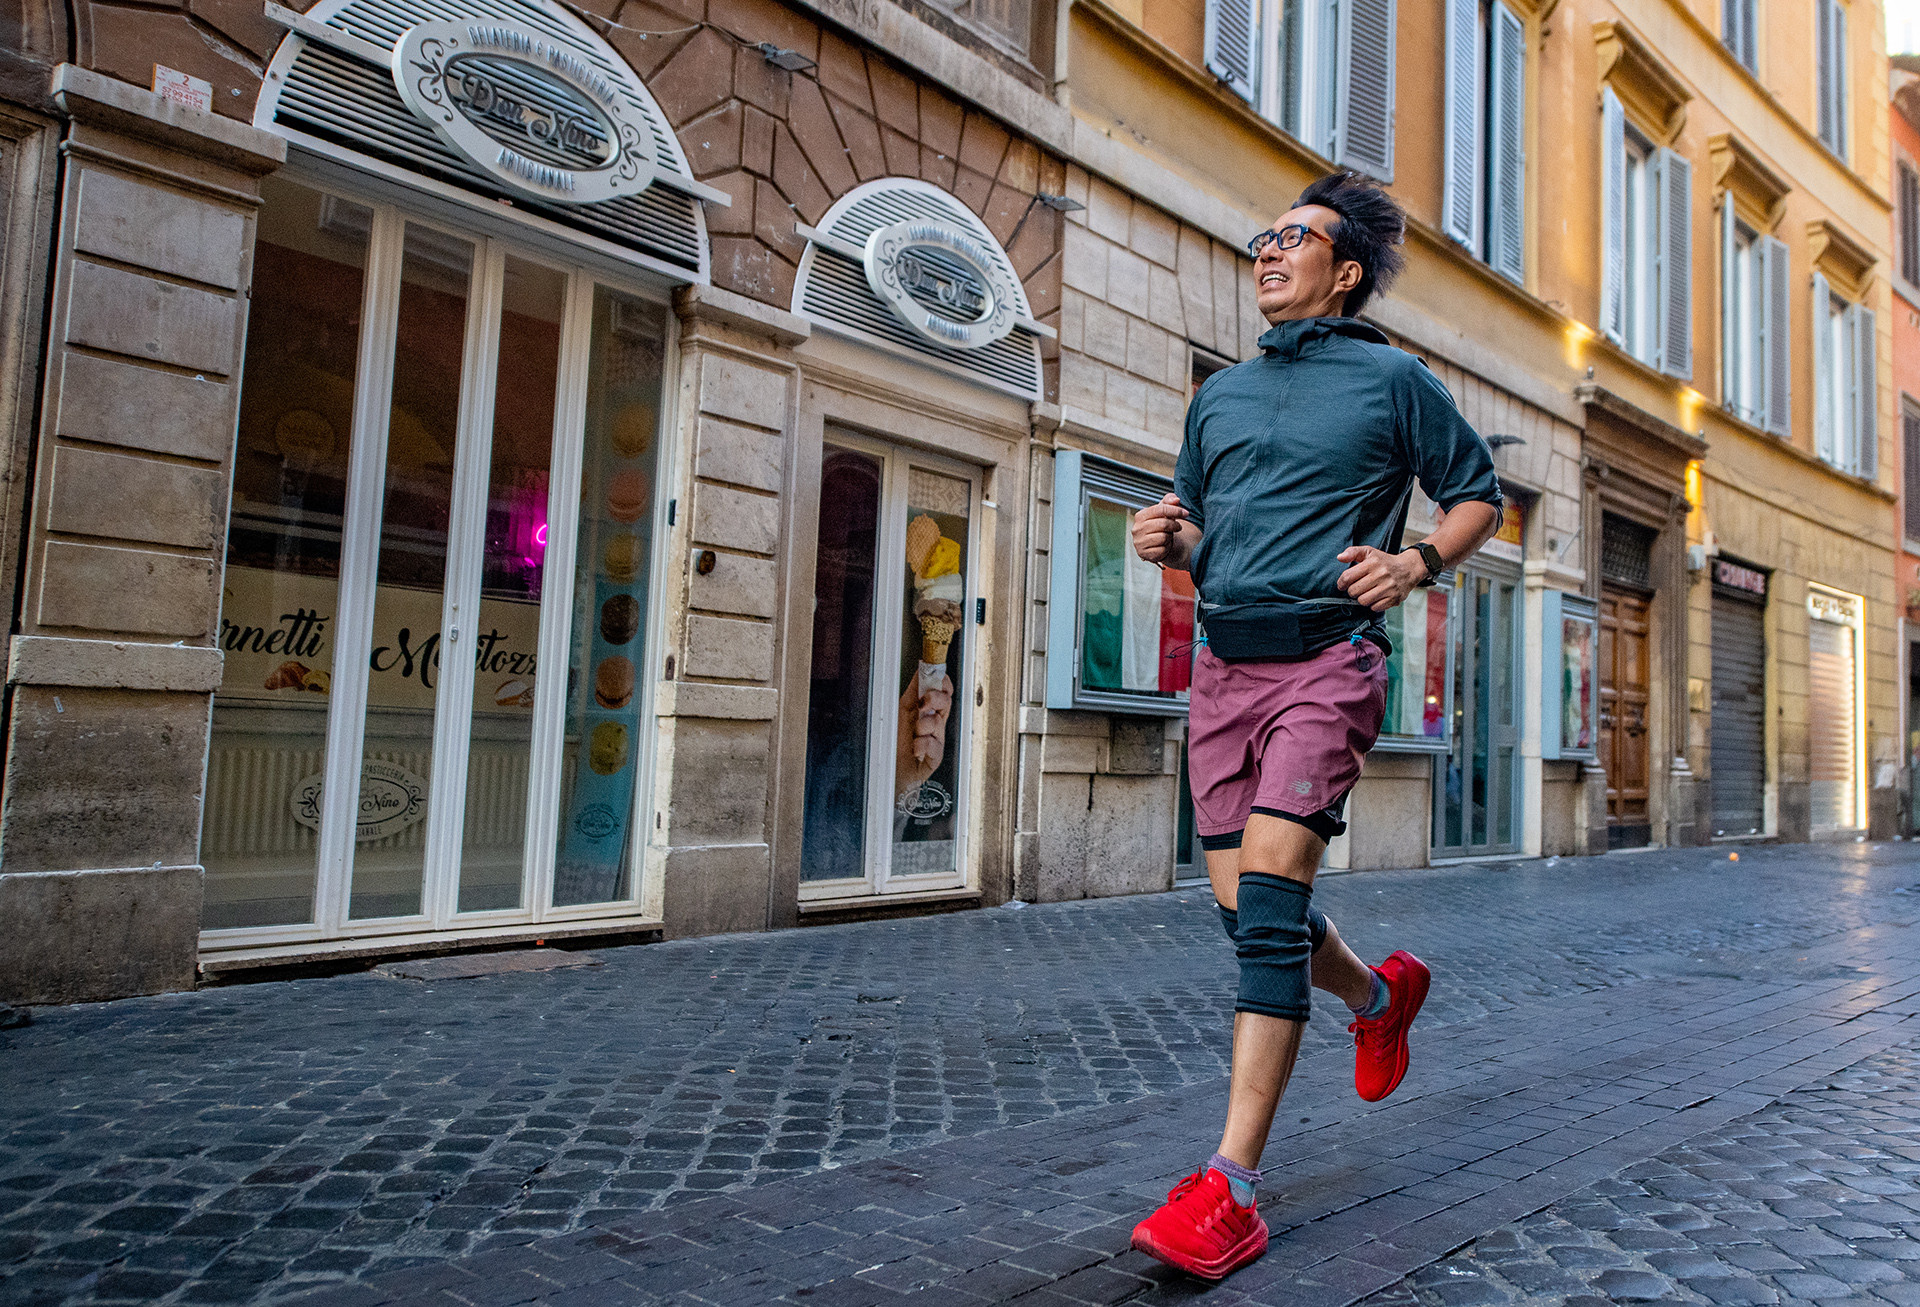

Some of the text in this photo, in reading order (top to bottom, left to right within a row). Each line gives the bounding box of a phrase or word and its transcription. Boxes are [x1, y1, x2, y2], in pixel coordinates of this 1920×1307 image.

[183, 75, 190, 86] 2
[467, 26, 532, 54] GELATERIA
[546, 45, 617, 105] PASTICCERIA
[458, 71, 600, 153] Don Nino
[496, 148, 577, 192] ARTIGIANALE
[361, 792, 399, 811] Nino
